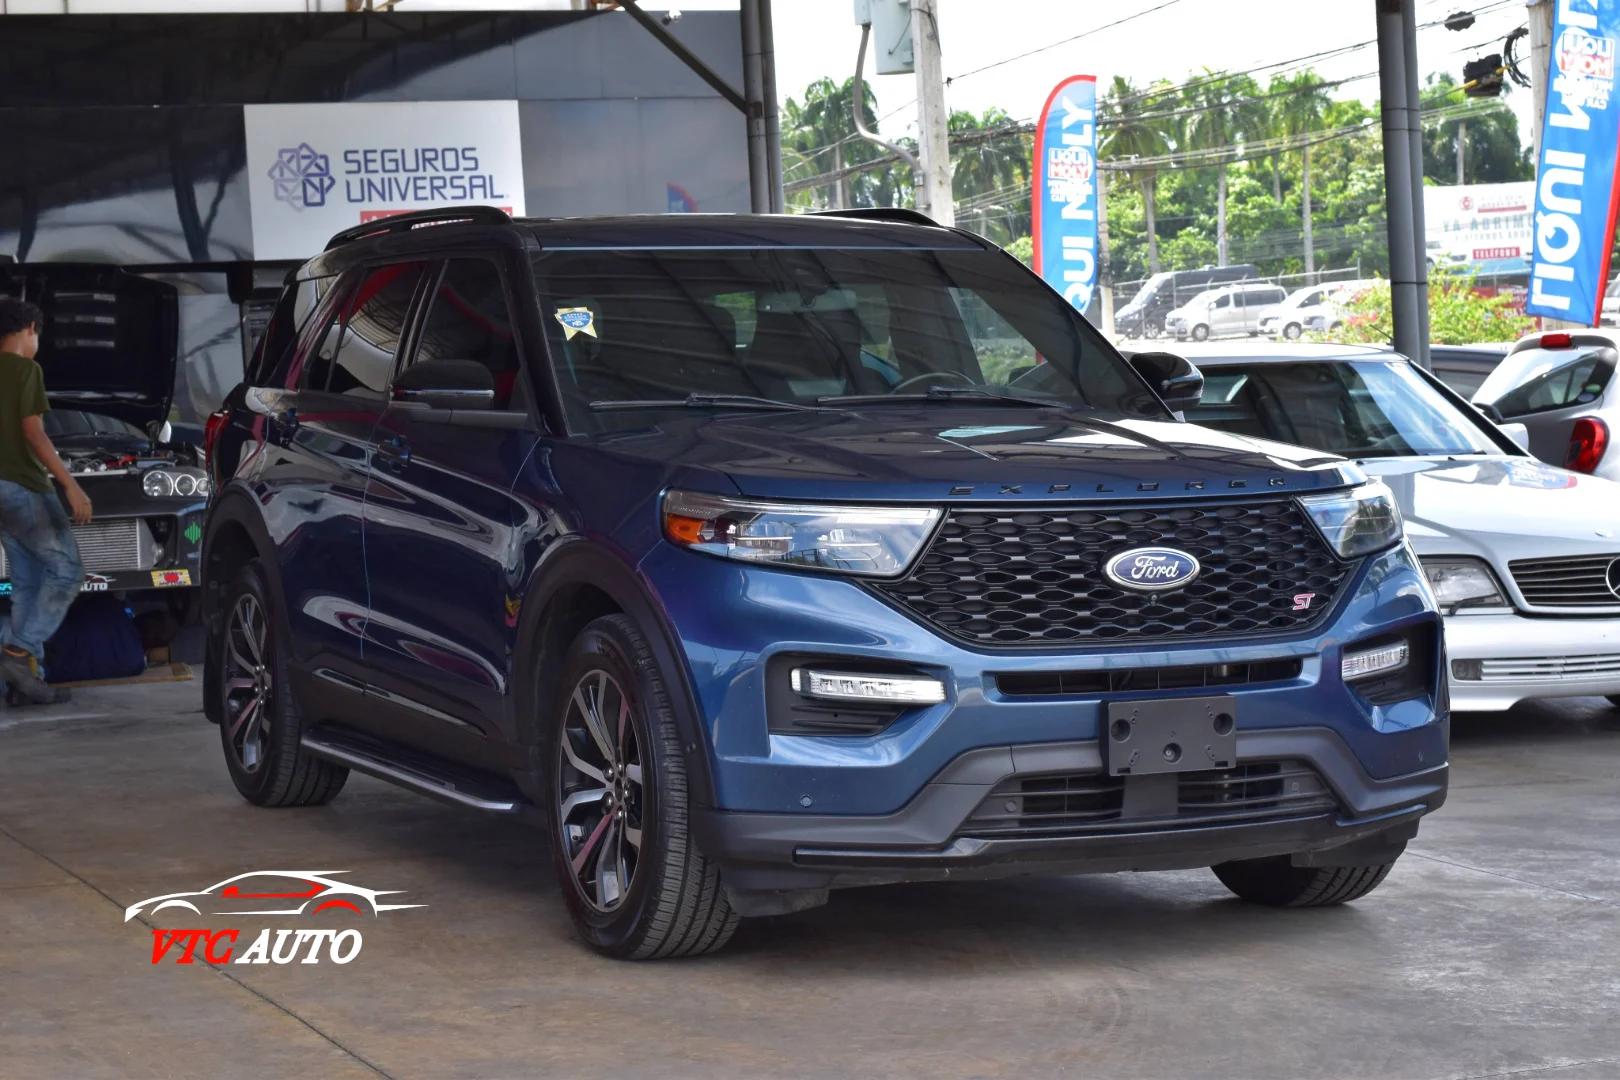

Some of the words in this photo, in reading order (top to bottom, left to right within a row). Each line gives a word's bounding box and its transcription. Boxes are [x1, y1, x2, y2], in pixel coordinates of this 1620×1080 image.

[343, 147, 480, 175] SEGUROS
[345, 175, 505, 203] UNIVERSAL
[1061, 235, 1096, 316] QUI
[948, 476, 1287, 496] EXPLORER
[1131, 555, 1179, 581] Ford
[1293, 593, 1315, 611] ST
